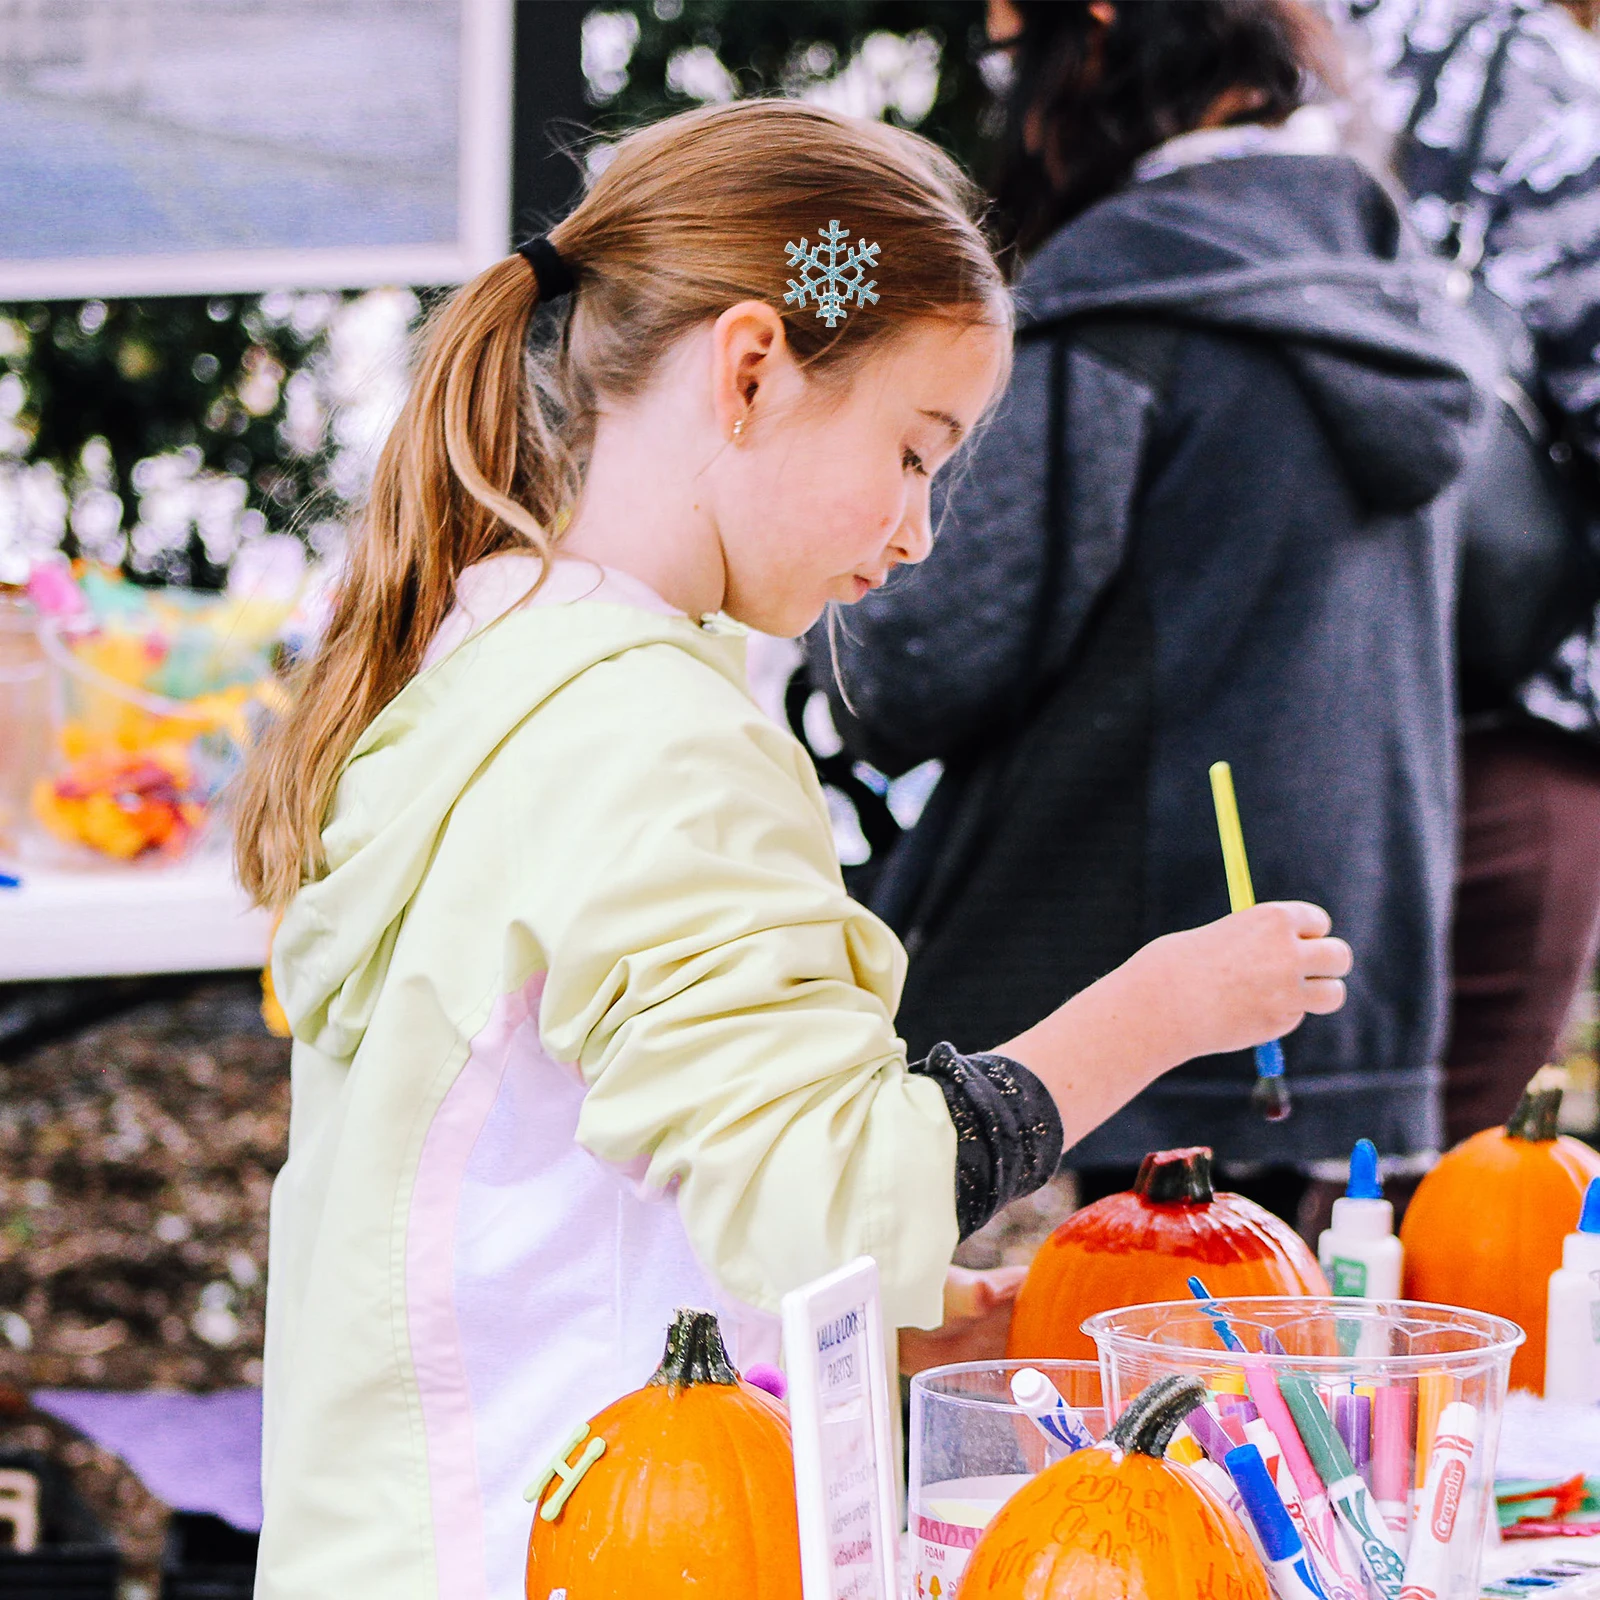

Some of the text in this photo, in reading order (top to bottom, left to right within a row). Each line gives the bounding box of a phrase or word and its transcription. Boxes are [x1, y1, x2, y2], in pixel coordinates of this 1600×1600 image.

[523, 1422, 607, 1522] H
[1434, 1469, 1463, 1538] Crayola
[925, 1545, 945, 1561] FOAM
